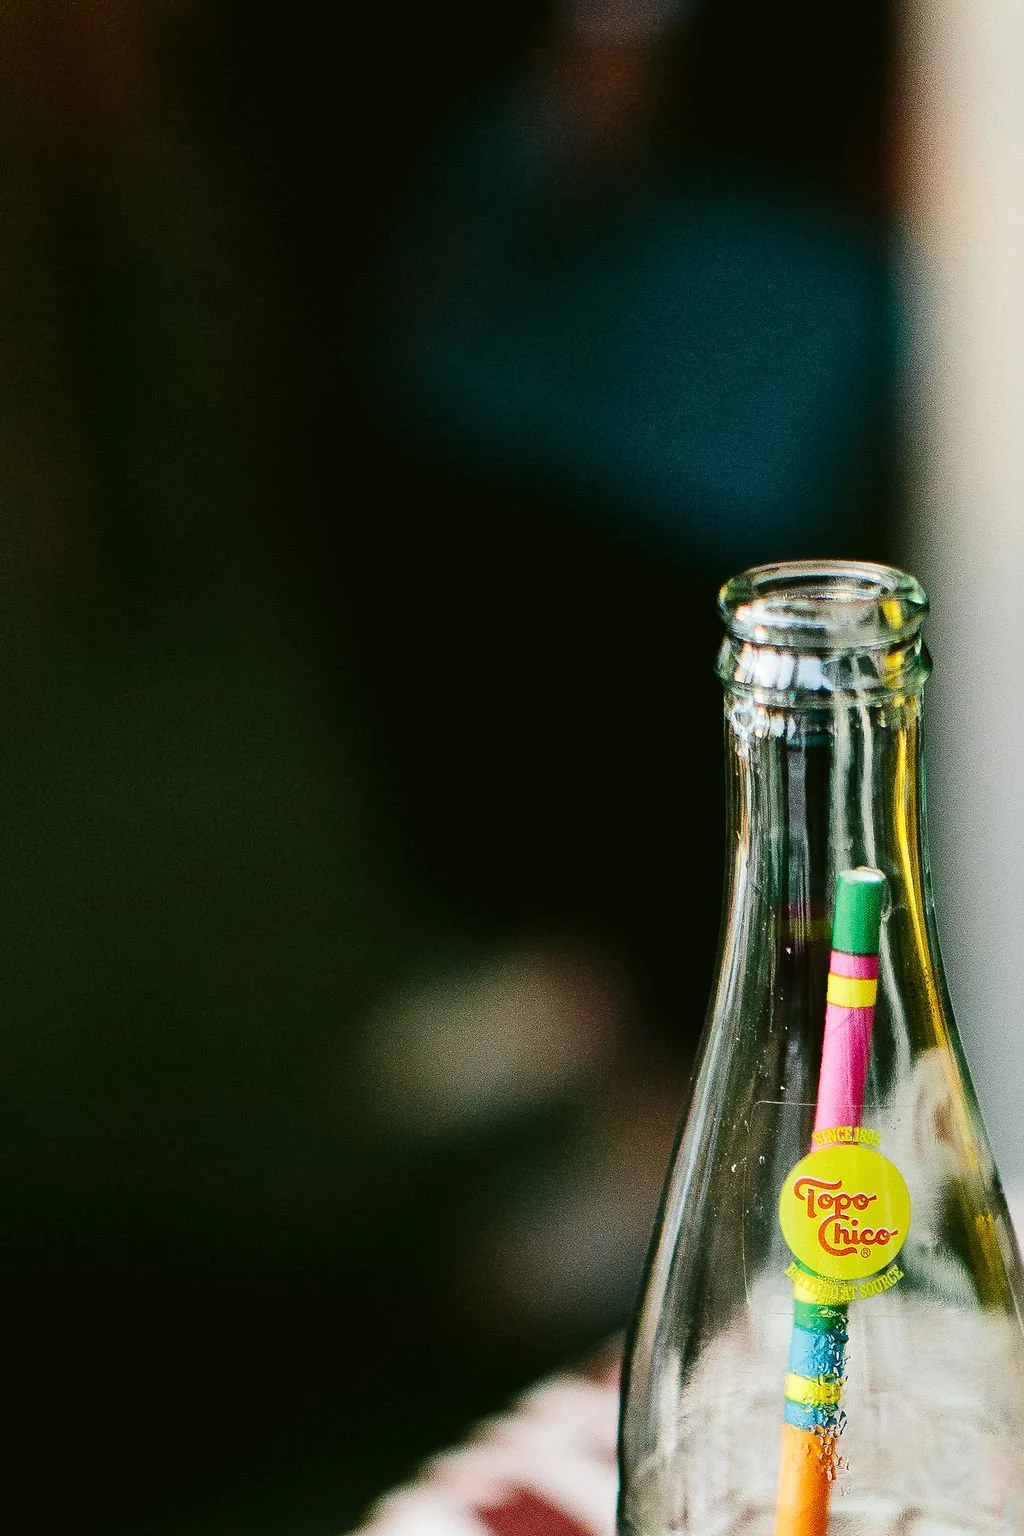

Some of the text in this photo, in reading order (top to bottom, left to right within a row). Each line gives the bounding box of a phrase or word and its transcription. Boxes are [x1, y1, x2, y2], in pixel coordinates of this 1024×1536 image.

[812, 1127, 852, 1146] SINCE
[793, 1176, 878, 1219] Topo
[818, 1214, 899, 1257] Chico
[860, 1264, 904, 1299] SOURCE
